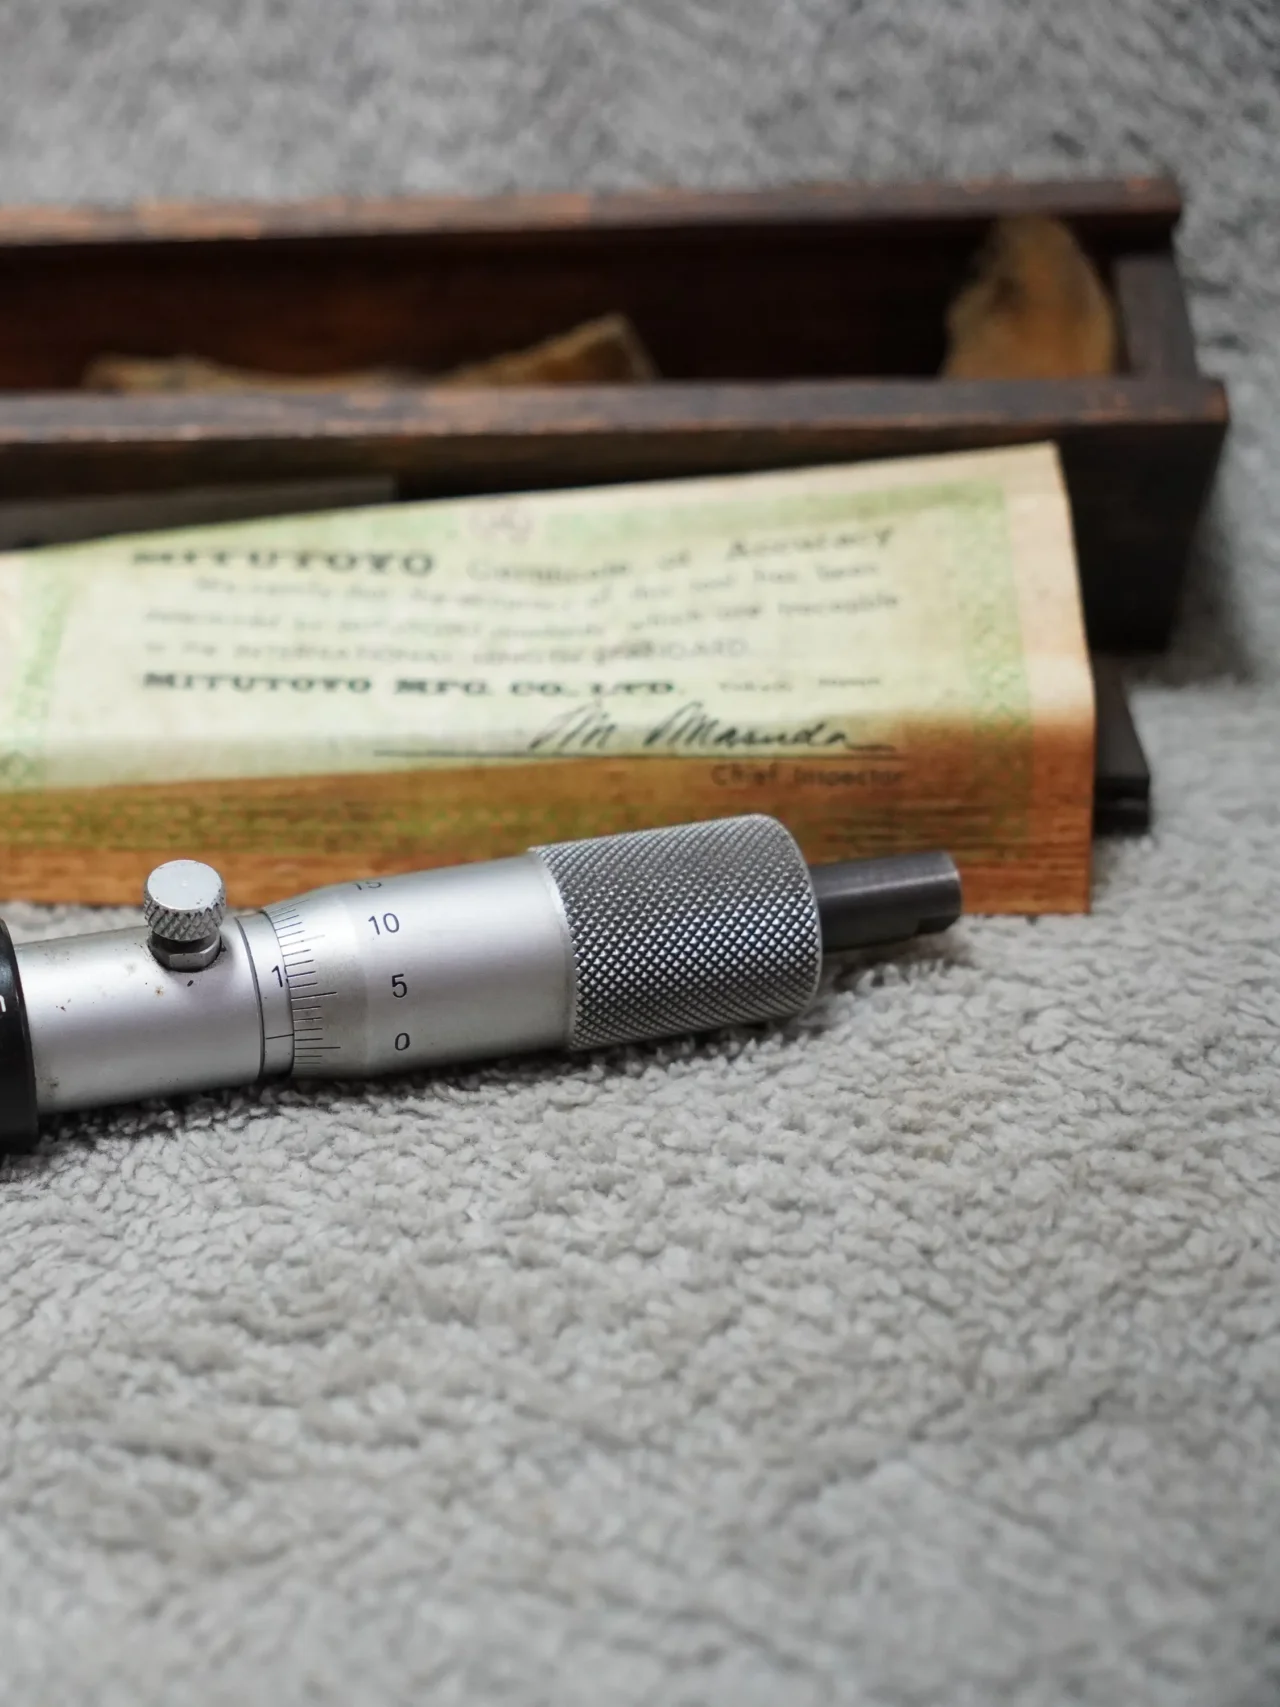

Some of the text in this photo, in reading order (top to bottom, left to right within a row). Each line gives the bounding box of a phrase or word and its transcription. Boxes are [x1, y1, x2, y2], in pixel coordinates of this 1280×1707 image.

[131, 549, 435, 578] MITUTOYO
[725, 526, 896, 561] Accuracy
[143, 672, 372, 693] MITUTOYO
[711, 762, 779, 787] Chief
[368, 912, 401, 936] 10
[391, 973, 408, 998] 5
[394, 1032, 411, 1051] 0
